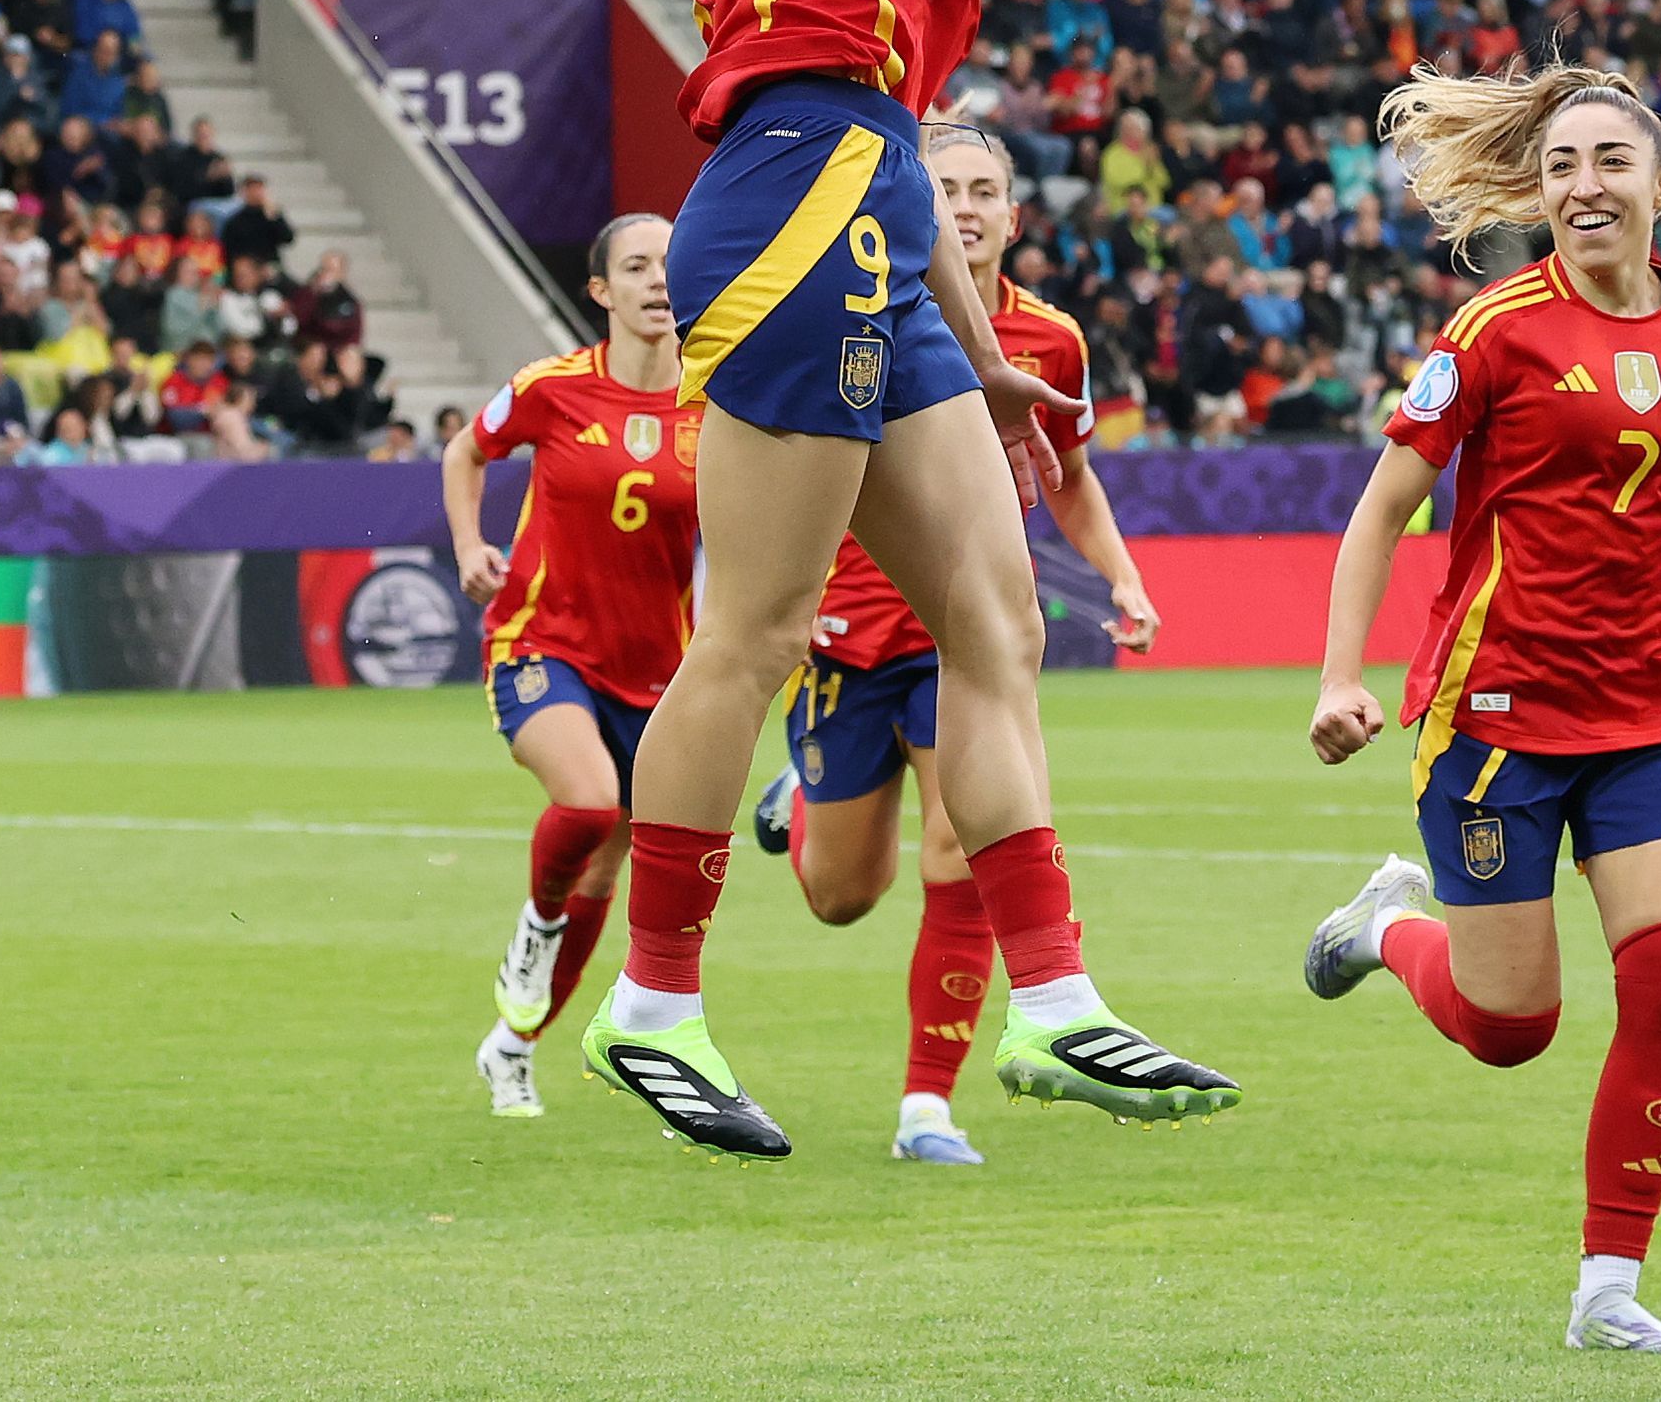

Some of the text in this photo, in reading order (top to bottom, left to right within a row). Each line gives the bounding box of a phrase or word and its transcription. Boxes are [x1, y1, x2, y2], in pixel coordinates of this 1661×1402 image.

[384, 67, 528, 146] E13
[845, 214, 891, 315] 9
[610, 469, 656, 533] 6
[1613, 429, 1660, 514] 7
